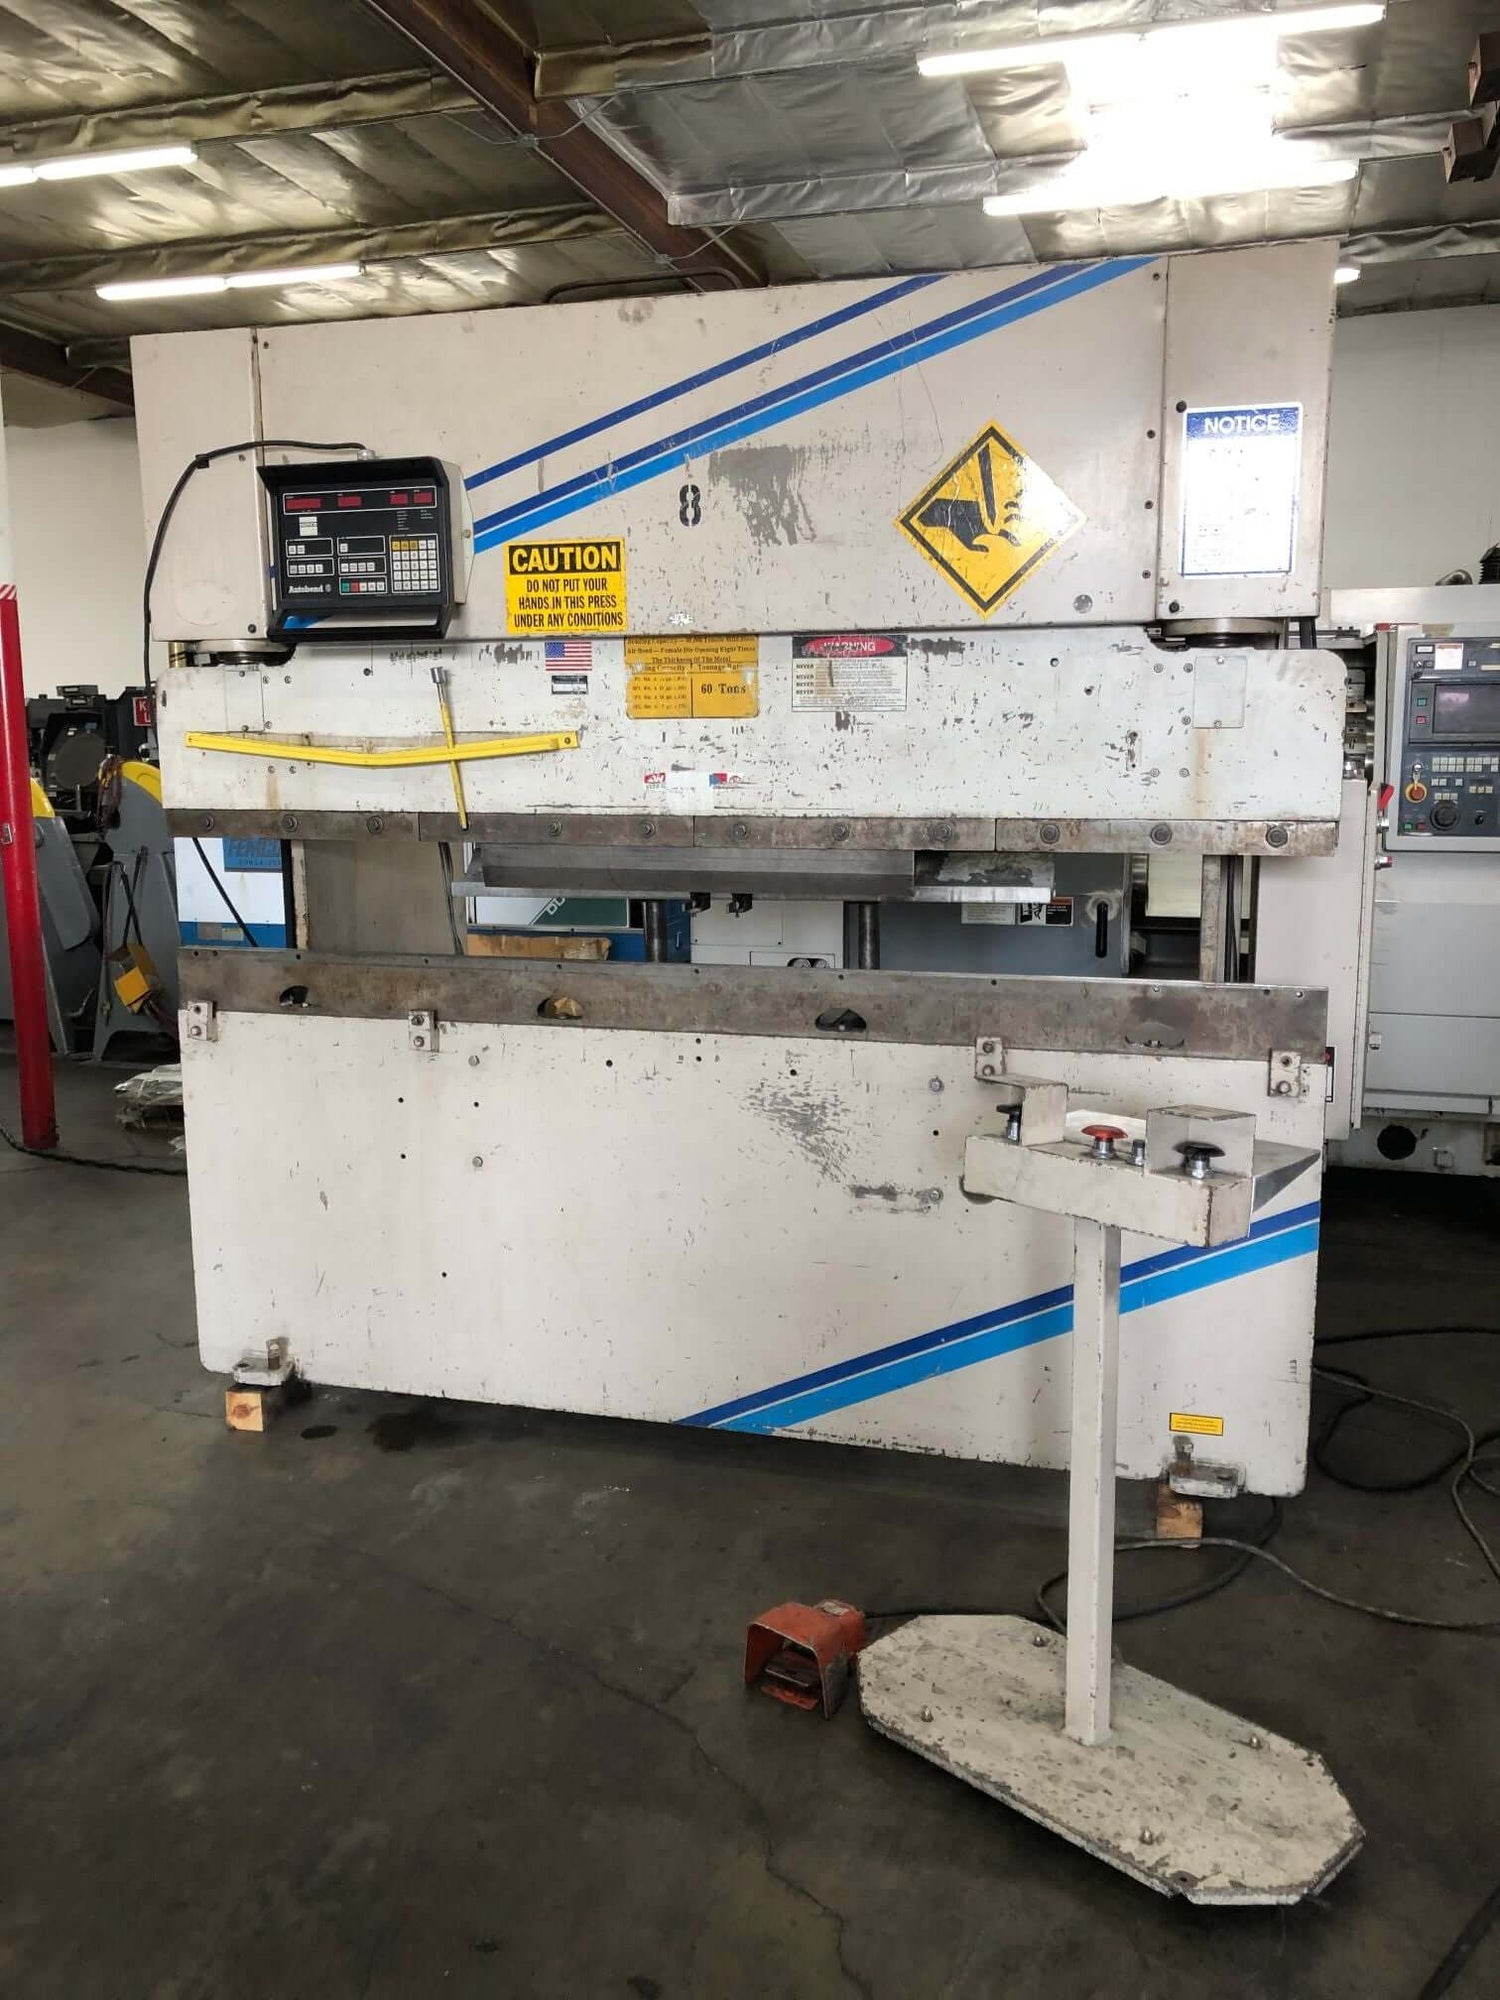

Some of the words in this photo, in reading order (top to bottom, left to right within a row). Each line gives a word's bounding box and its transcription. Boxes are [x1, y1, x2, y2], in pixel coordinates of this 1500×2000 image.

[1204, 414, 1281, 434] NOTICE
[679, 484, 701, 527] 8
[512, 545, 617, 572] CAUTION
[526, 579, 540, 593] DO
[543, 579, 560, 592] NOT
[563, 578, 580, 592] PUT
[584, 578, 607, 591] YOUR
[519, 596, 549, 610] HANDS
[552, 596, 561, 610] IN
[564, 595, 585, 609] THIS
[588, 595, 617, 608] PRESS
[514, 613, 545, 628] UNDER
[547, 612, 564, 627] ANY
[567, 611, 624, 627] CONDITIONS
[824, 641, 876, 652] WARNING
[701, 683, 713, 695] 60
[718, 682, 746, 694] Tons
